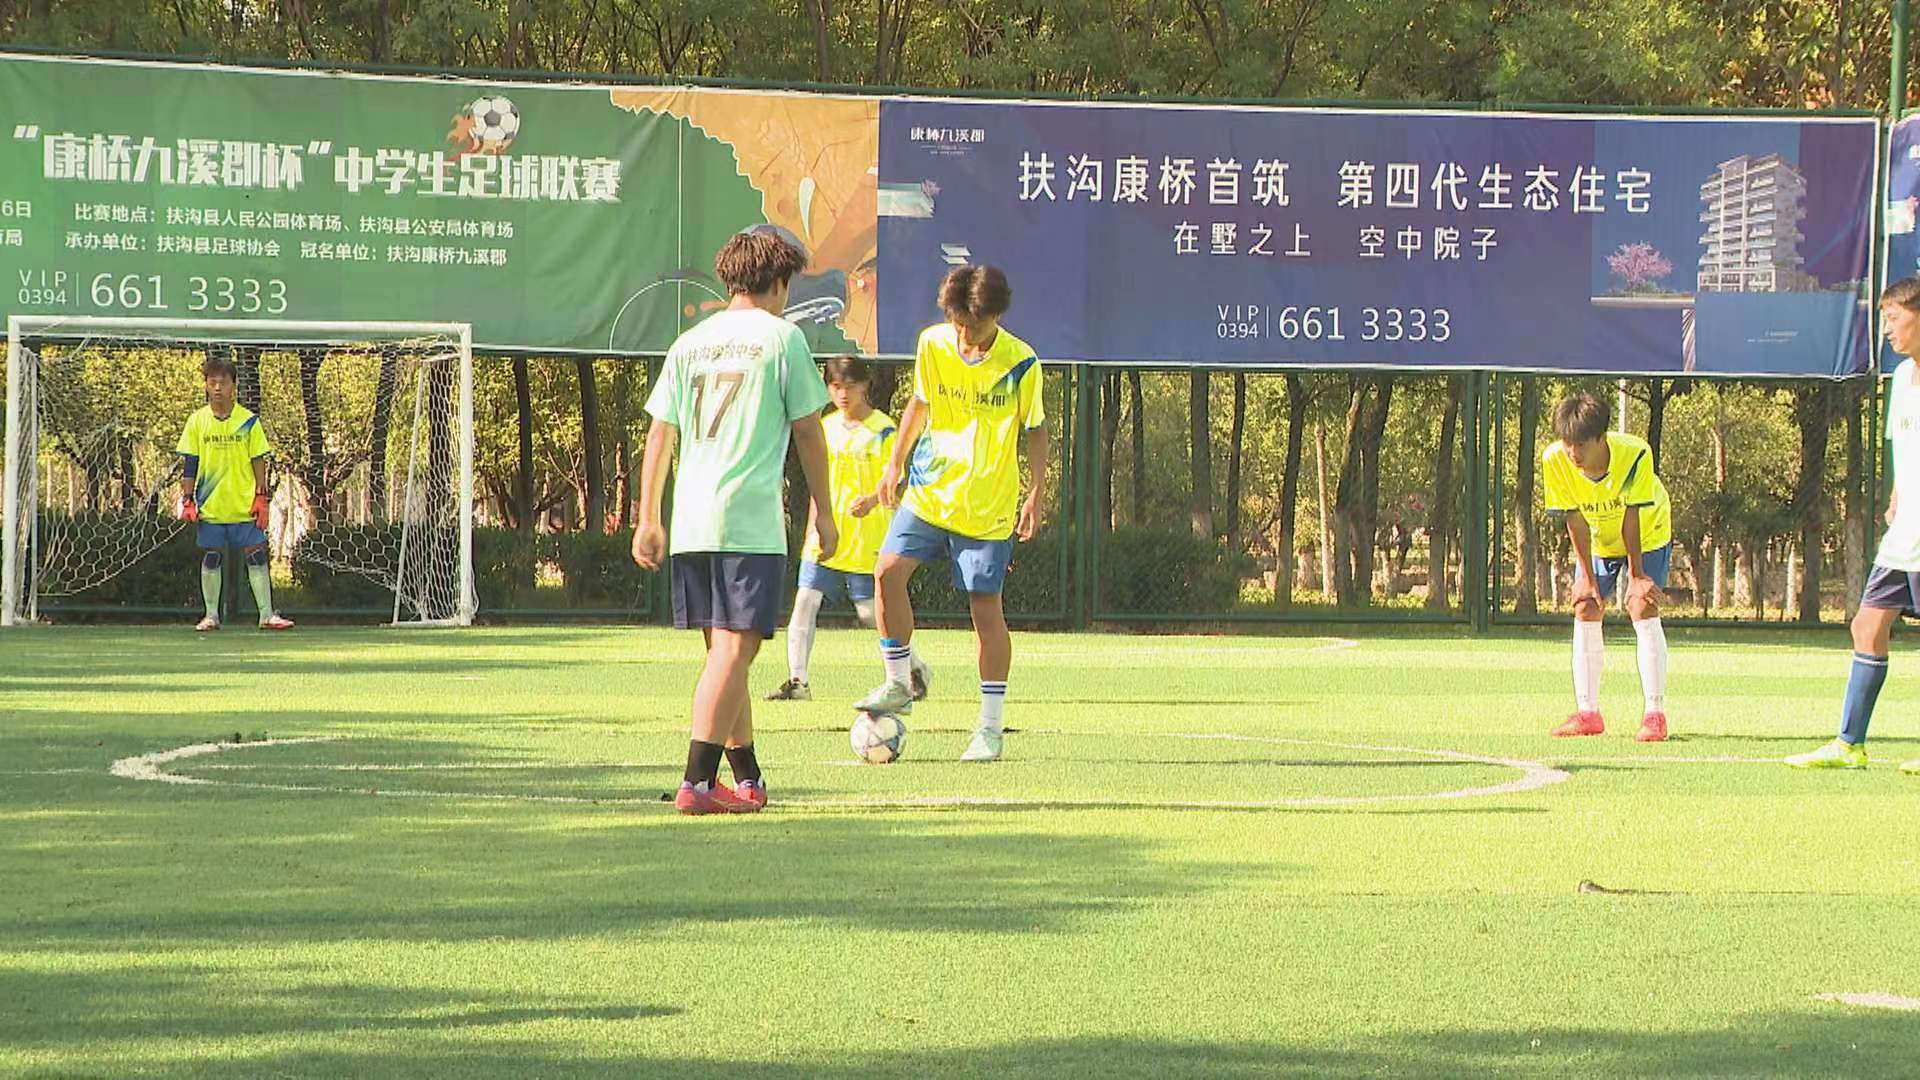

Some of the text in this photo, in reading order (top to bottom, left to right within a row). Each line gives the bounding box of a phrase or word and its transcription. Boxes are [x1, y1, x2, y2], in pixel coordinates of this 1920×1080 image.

[1018, 151, 1653, 214] 扶沟康桥首筑 第四代生态住宅
[0, 229, 23, 247] 局
[1173, 221, 1498, 260] 在墅之上 空中院子
[18, 269, 67, 287] VIP
[18, 288, 67, 305] 0394
[90, 272, 289, 314] 661 3333
[1217, 304, 1259, 321] VIP
[1278, 306, 1452, 343] 661 3333
[1217, 322, 1259, 339] 0394
[691, 370, 746, 441] 17
